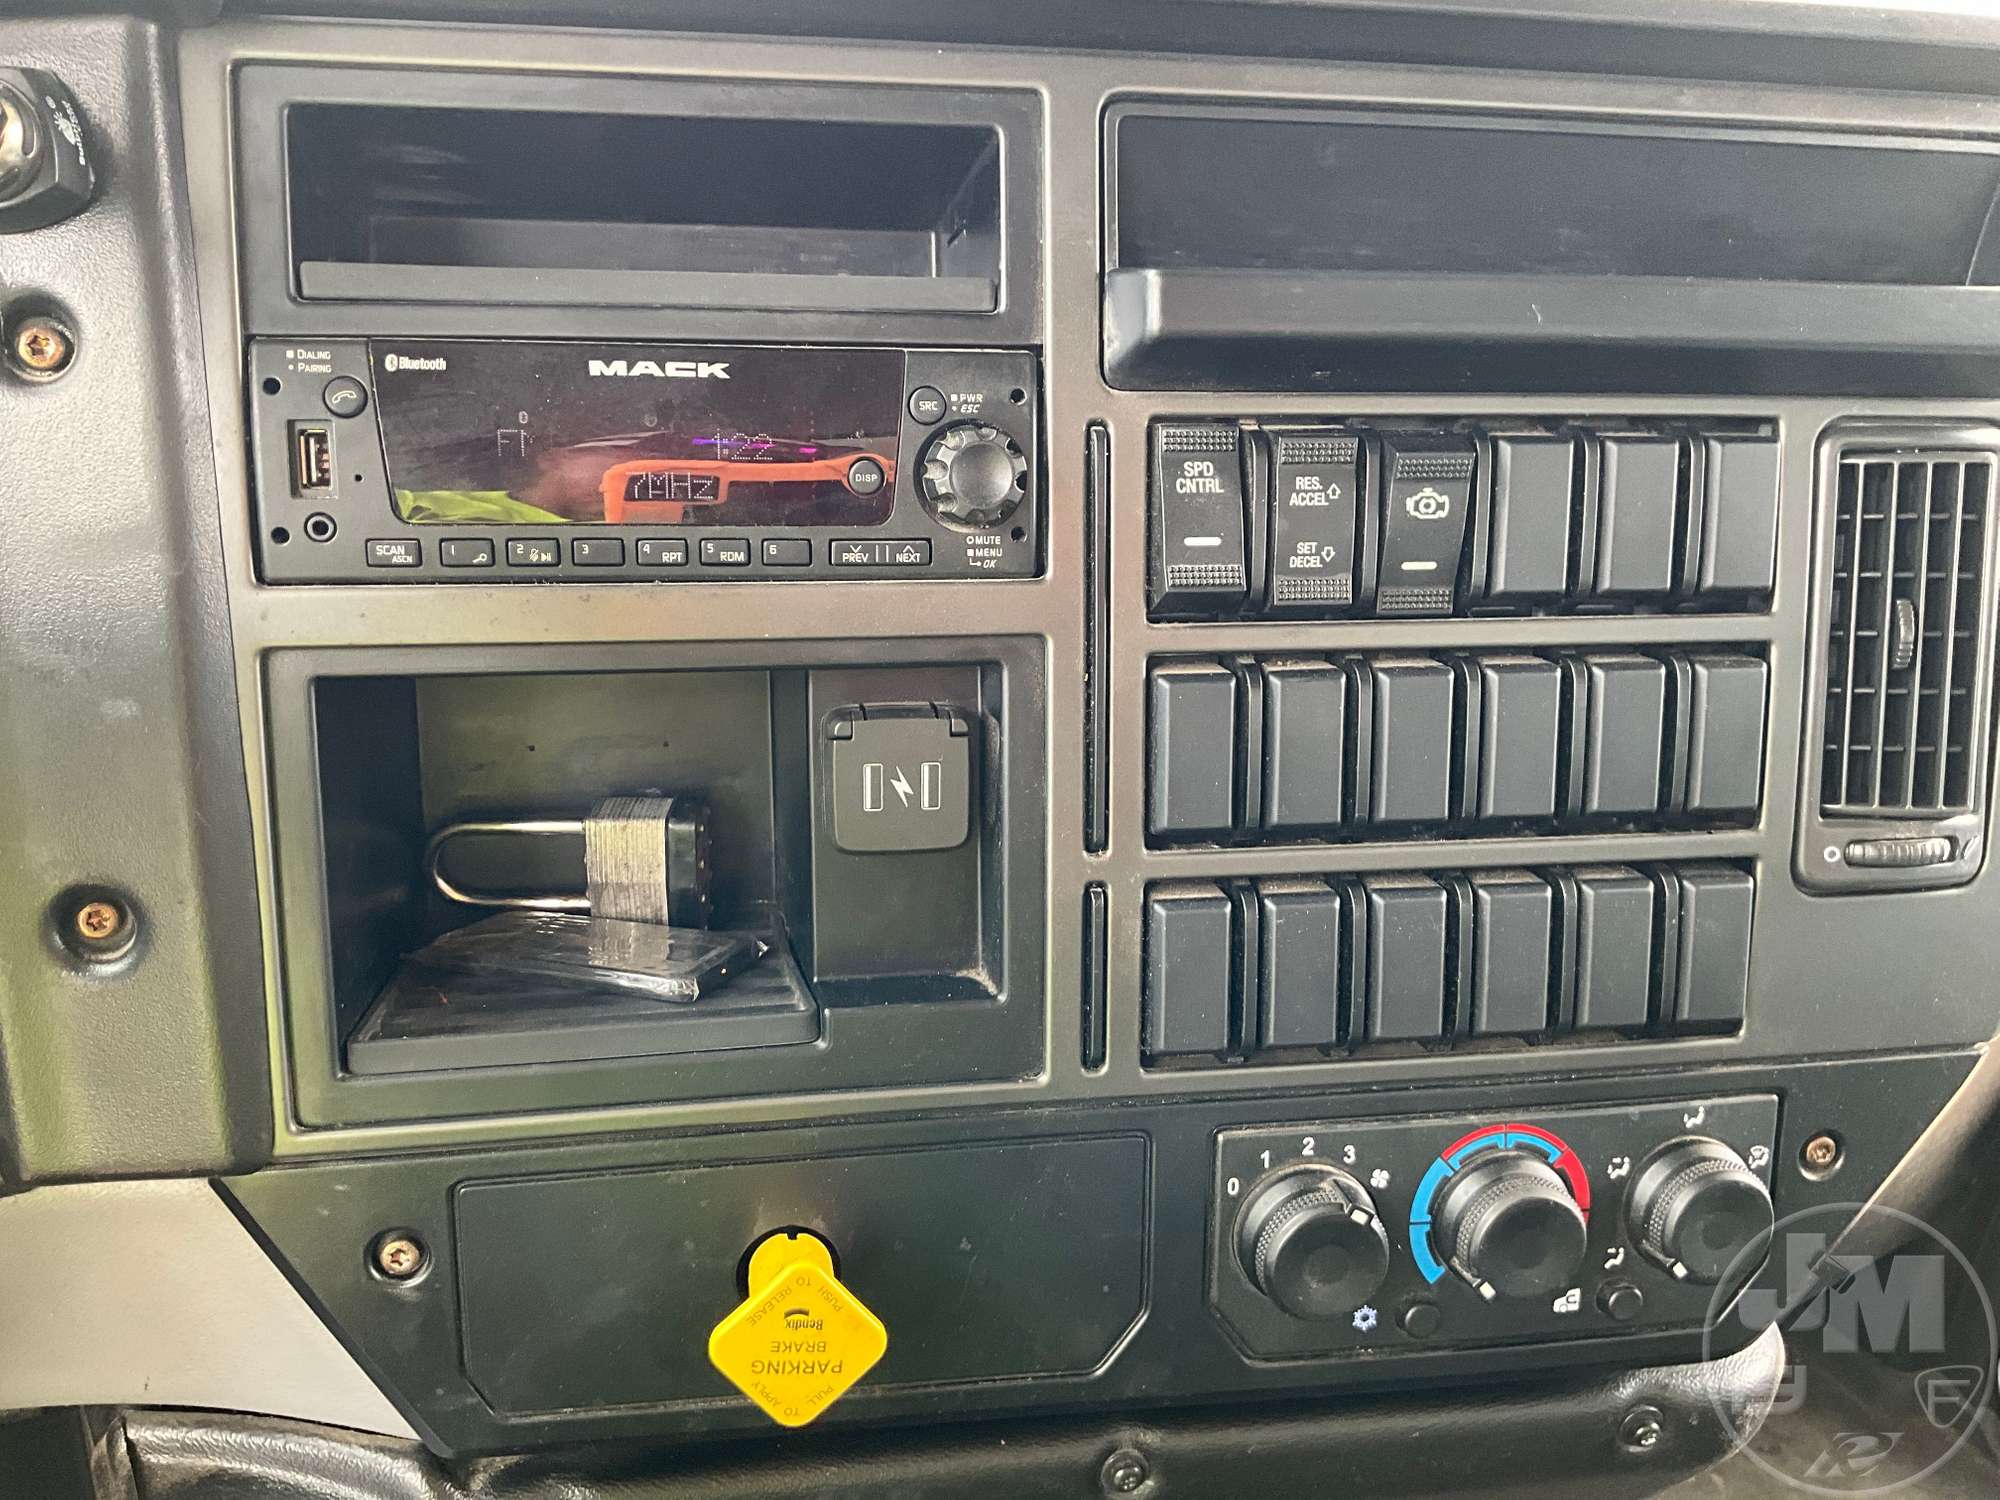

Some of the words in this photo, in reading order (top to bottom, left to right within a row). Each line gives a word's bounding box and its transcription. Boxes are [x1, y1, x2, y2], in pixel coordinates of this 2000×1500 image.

[297, 349, 331, 360] DIALING
[298, 362, 332, 373] PAIRING
[399, 356, 447, 371] Bluetooth
[588, 360, 730, 379] MACK
[960, 393, 983, 402] PWR
[919, 401, 938, 411] SRC
[961, 404, 980, 413] ESC
[1183, 461, 1214, 477] SPD
[855, 473, 878, 482] DISP
[1295, 476, 1323, 490] RES.
[1175, 478, 1225, 493] CNTRL
[1289, 492, 1329, 506] ACCEL
[975, 535, 1001, 545] MUTE
[376, 545, 405, 556] SCAN
[451, 545, 455, 556] 1
[516, 544, 524, 554] 2
[582, 544, 589, 555] 3
[643, 544, 650, 554] 4
[706, 544, 714, 554] 5
[769, 545, 777, 555] 6
[975, 548, 1003, 557] MENU
[1296, 541, 1318, 555] SET
[662, 553, 683, 563] RPT
[720, 552, 745, 562] RDM
[842, 553, 868, 563] PREV
[896, 553, 921, 563] NEXT
[1289, 556, 1323, 569] DECEL
[983, 559, 997, 569] OK
[1301, 1137, 1315, 1156] 2
[1260, 1150, 1270, 1168] 1
[1343, 1145, 1356, 1164] 3
[1227, 1177, 1239, 1195] 0
[796, 1276, 812, 1286] TO
[818, 1286, 843, 1312] PUSH
[746, 1286, 792, 1326] RELEASE
[784, 1318, 823, 1331] Bendix
[770, 1341, 827, 1353] BRAKE
[751, 1360, 843, 1374] PARKING
[751, 1381, 784, 1407] APPLY
[807, 1384, 834, 1406] PULL
[783, 1407, 799, 1417] TO
